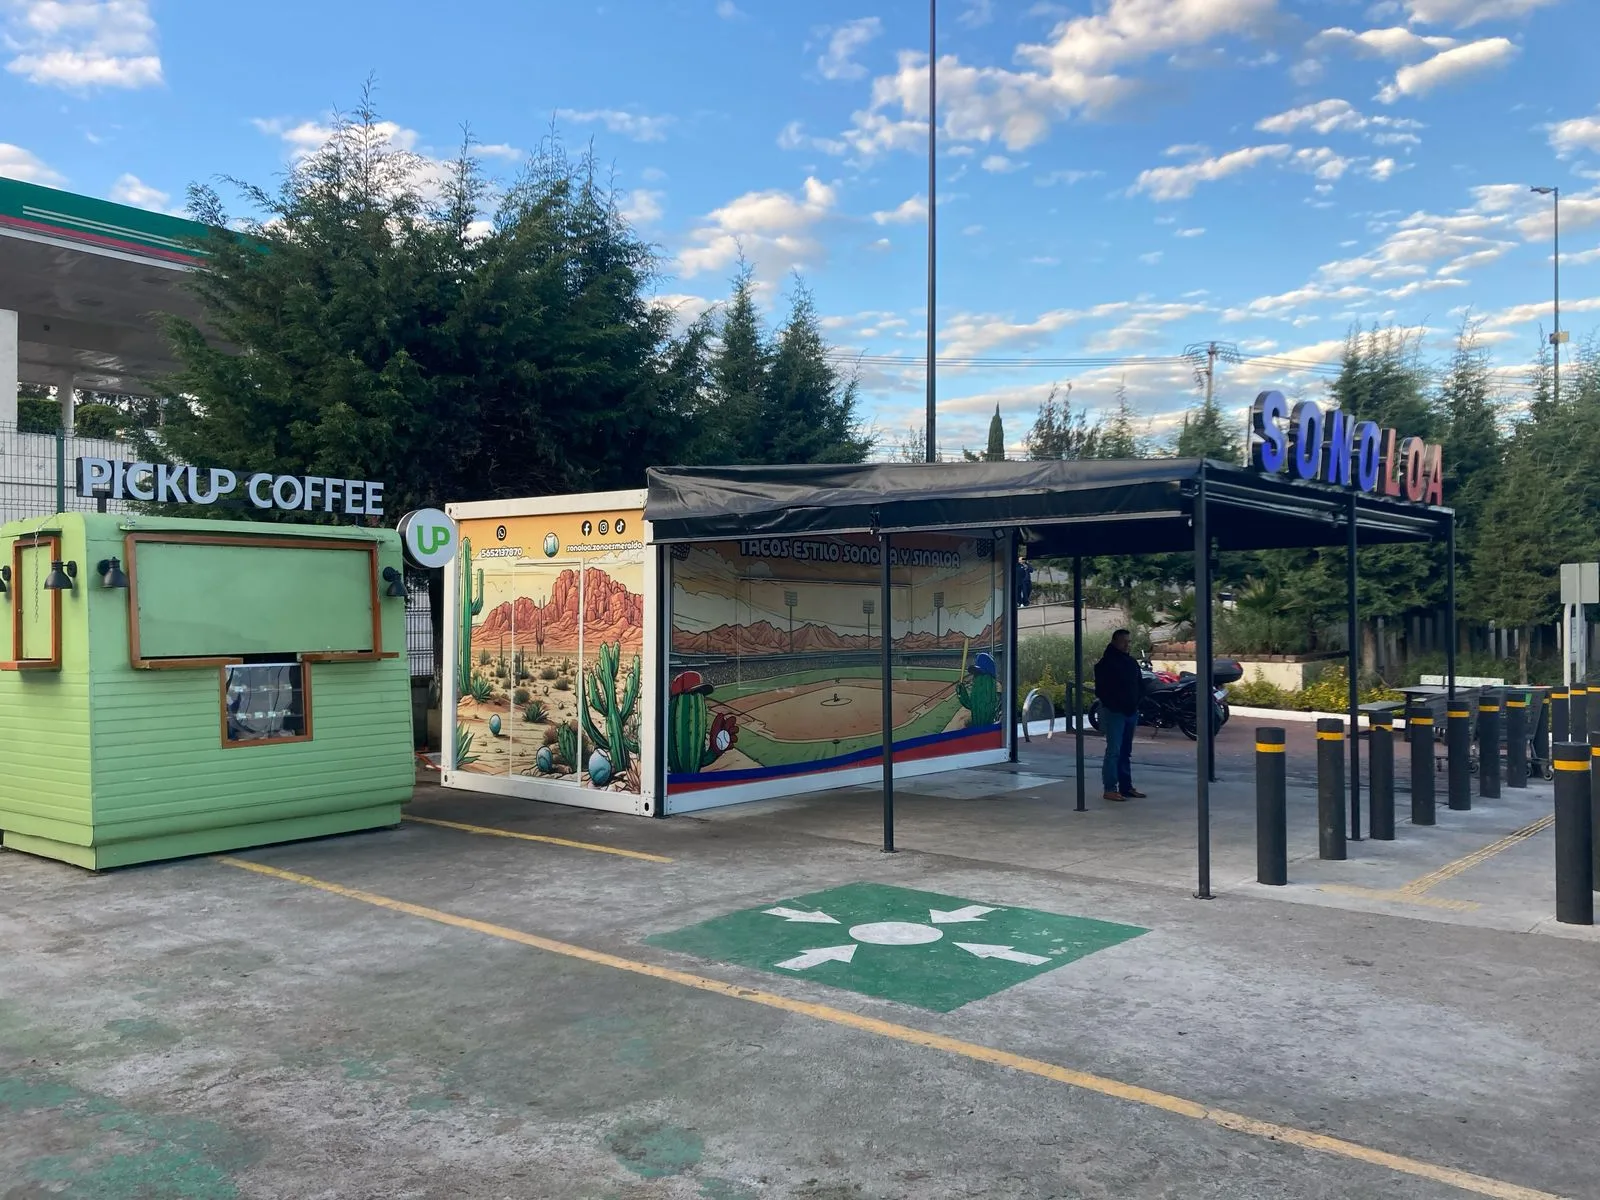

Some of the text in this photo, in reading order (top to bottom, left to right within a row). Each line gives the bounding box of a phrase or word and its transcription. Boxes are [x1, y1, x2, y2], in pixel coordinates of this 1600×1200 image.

[1255, 390, 1443, 506] SONOLOA
[80, 457, 385, 516] PICKUP COFFEE
[416, 524, 451, 556] UP
[738, 538, 960, 568] TACOS ESTILO SONOA Y SINALOA
